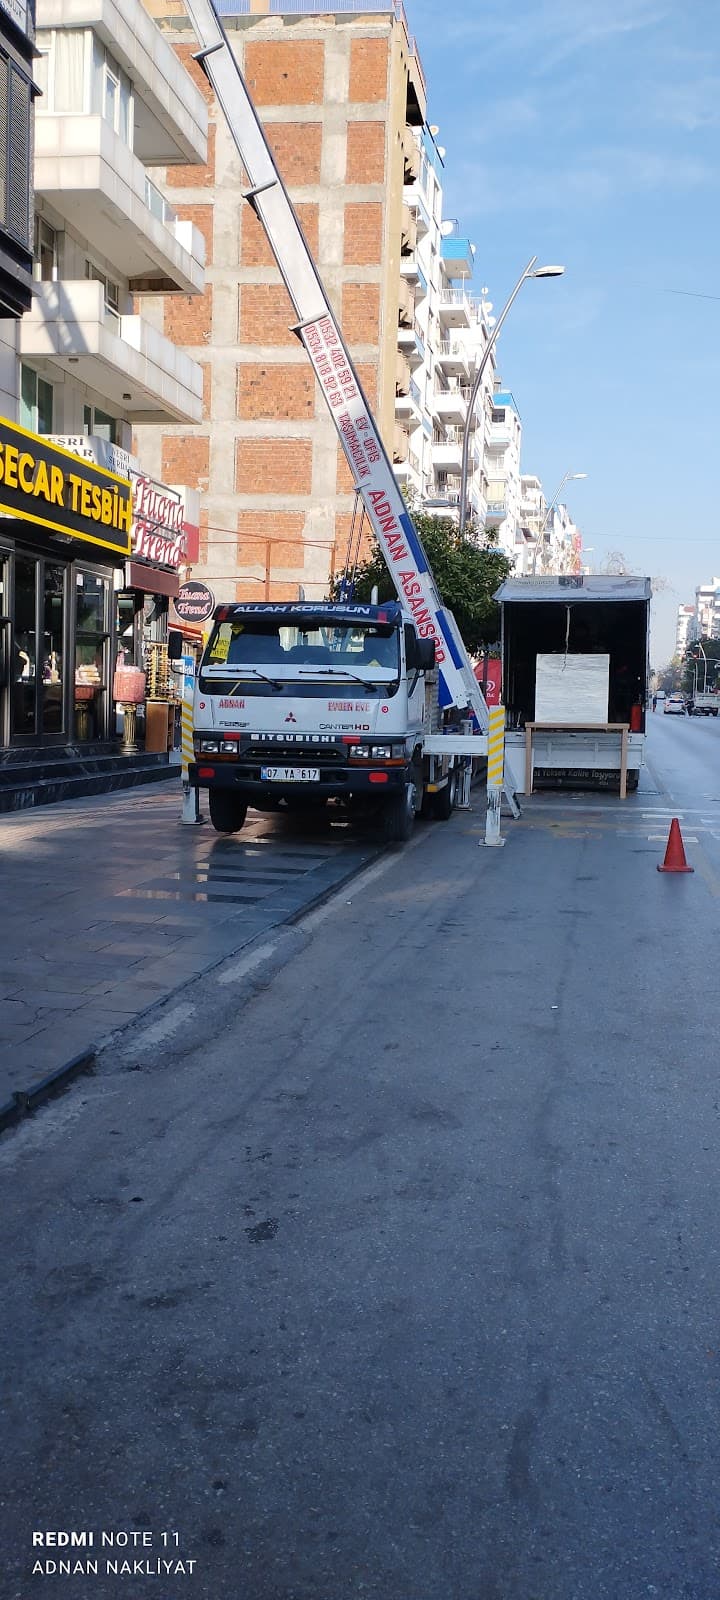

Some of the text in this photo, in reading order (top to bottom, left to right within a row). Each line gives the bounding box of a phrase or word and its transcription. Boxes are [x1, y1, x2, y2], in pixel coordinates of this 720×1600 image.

[304, 325, 343, 407] 0534 818 92 63
[318, 319, 357, 399] 0532 402 59 21
[355, 416, 369, 430] EV
[70, 473, 131, 532] TESBİH
[367, 489, 409, 562] ADNAN
[132, 522, 187, 568] Trend
[177, 602, 211, 614] Trend
[233, 605, 371, 614] ALLAH KORUSUN
[250, 733, 336, 743] MITSUBISHI
[267, 769, 317, 779] 07 YA 617
